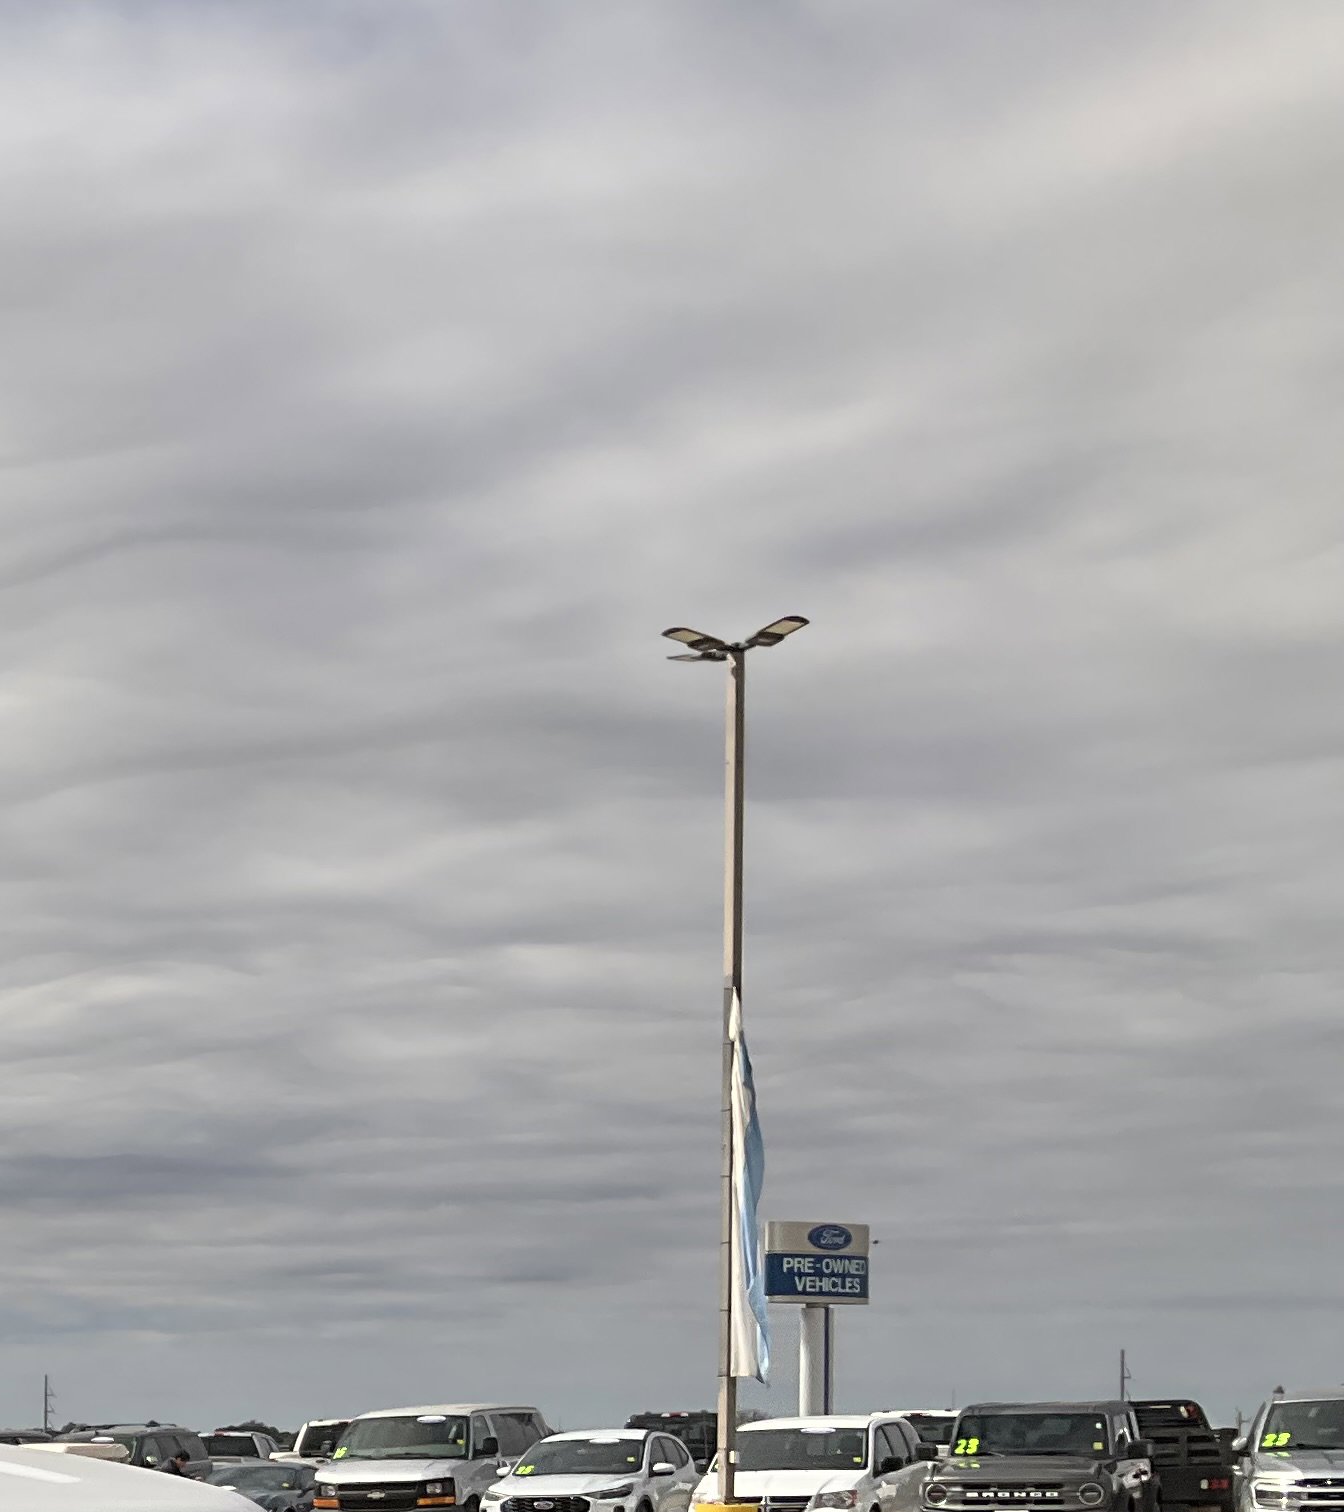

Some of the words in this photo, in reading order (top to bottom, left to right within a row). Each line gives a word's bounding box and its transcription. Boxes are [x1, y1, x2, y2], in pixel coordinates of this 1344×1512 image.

[820, 1229, 845, 1245] Ford
[782, 1257, 866, 1275] PRE-OWNED
[794, 1276, 861, 1293] VEHICLES
[954, 1438, 980, 1455] 23
